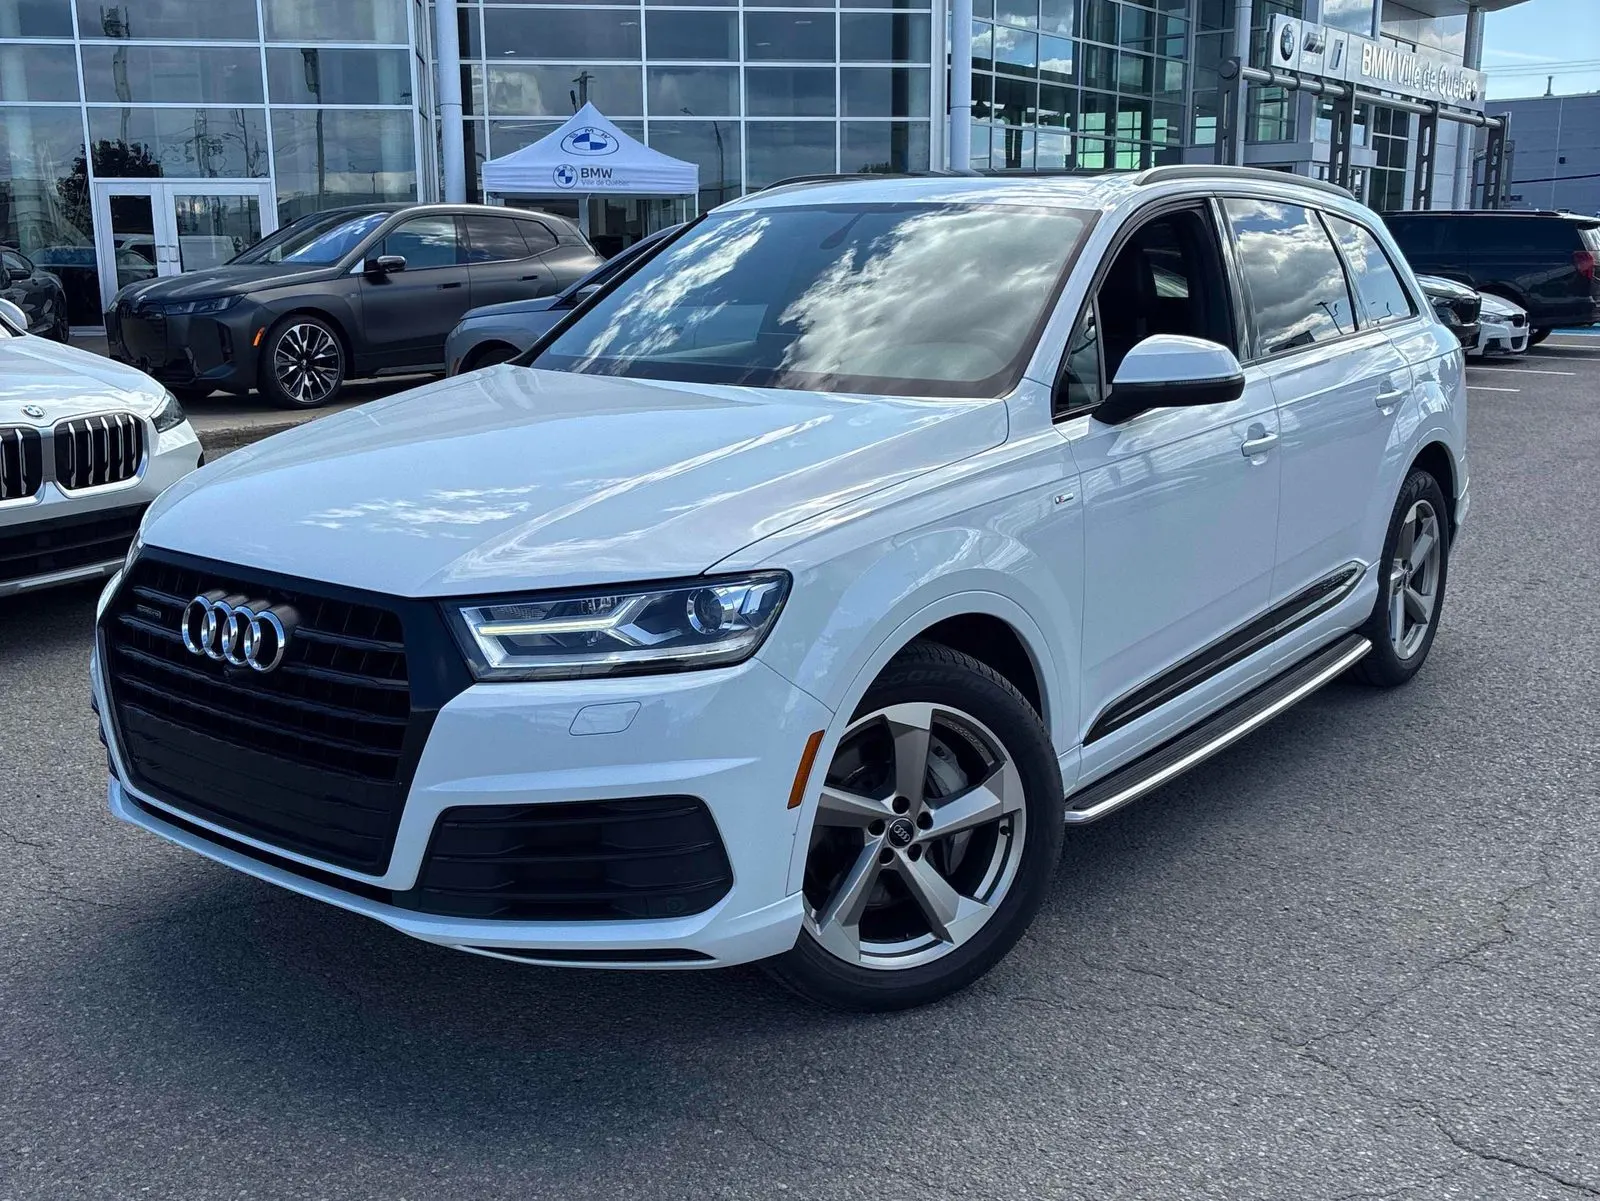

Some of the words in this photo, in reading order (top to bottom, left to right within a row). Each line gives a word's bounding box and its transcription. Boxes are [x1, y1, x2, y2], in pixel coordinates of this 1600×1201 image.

[1361, 43, 1396, 82] BMW
[1396, 52, 1420, 89] Ville
[1422, 61, 1437, 92] de
[580, 167, 613, 179] BMW
